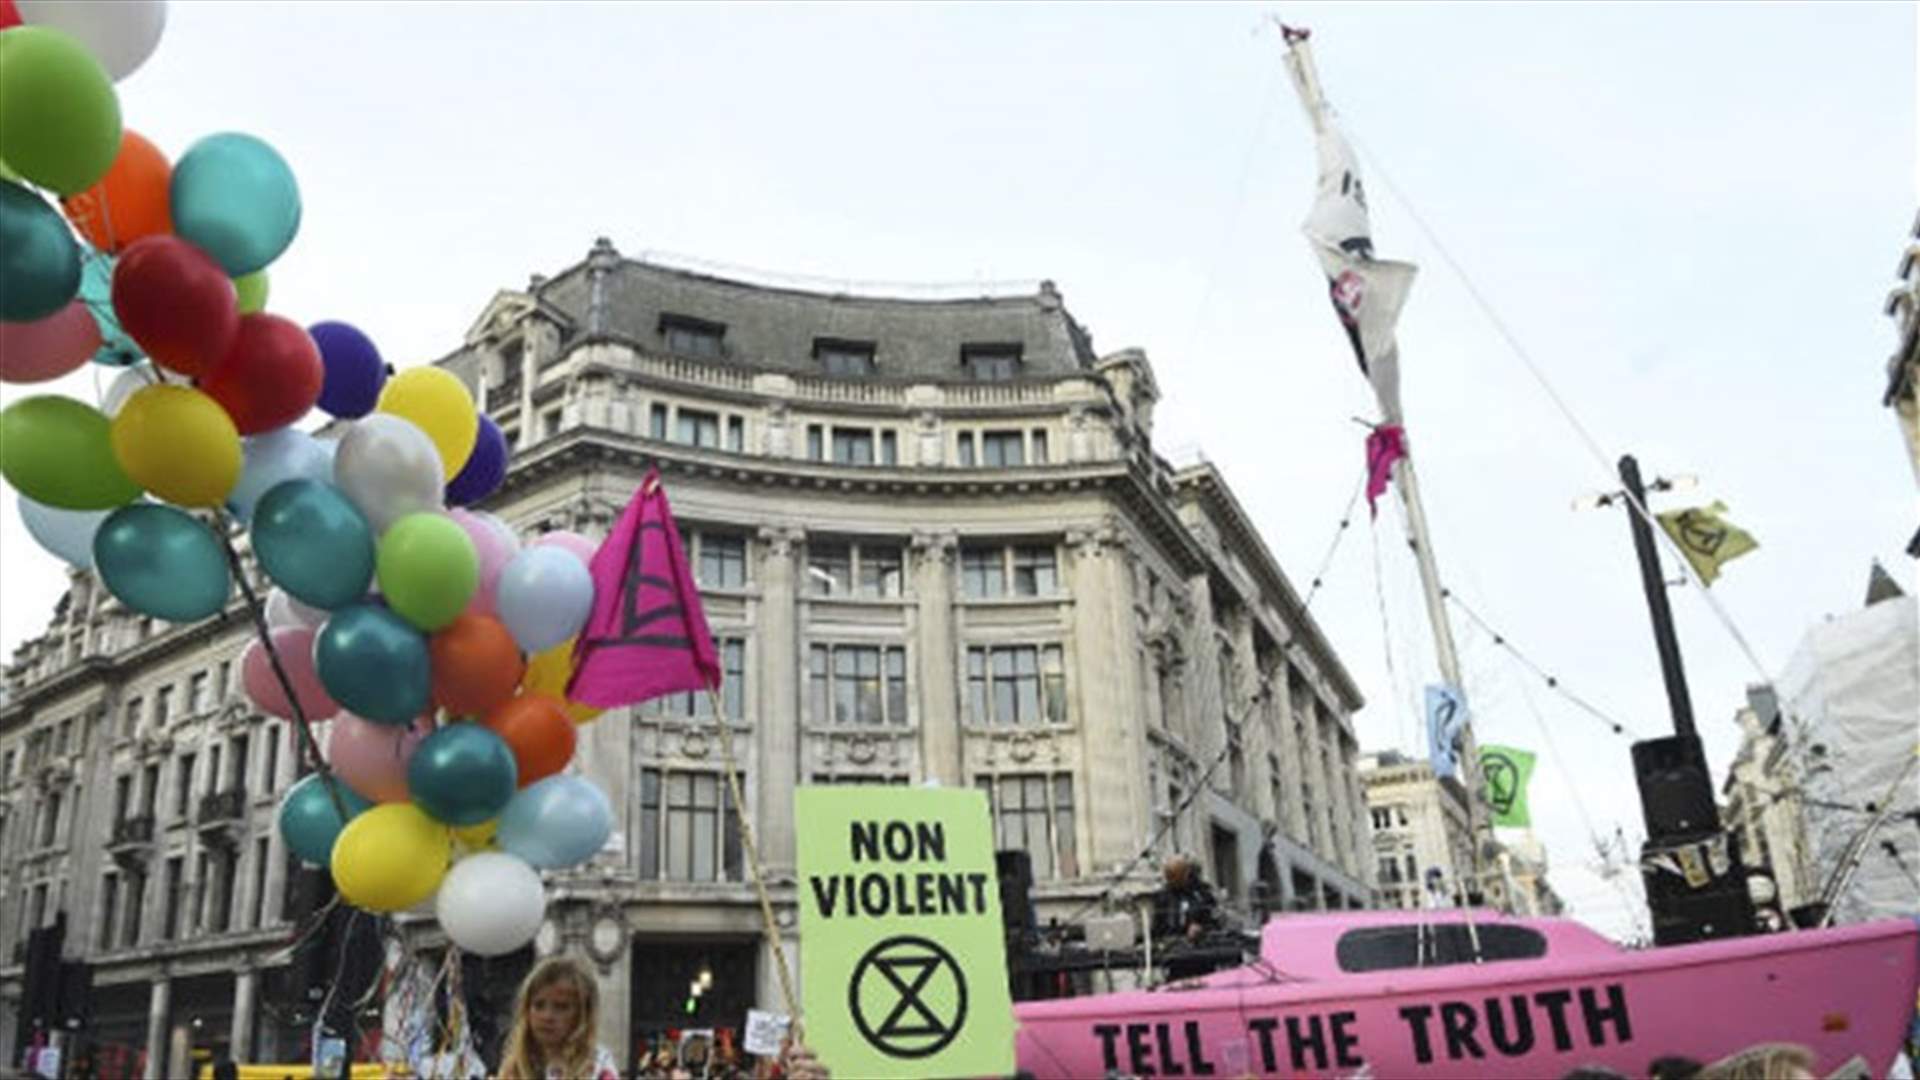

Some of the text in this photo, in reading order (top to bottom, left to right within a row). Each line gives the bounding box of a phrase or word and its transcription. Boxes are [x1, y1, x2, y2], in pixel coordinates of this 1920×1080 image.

[850, 821, 946, 863] NON
[810, 873, 988, 918] VIOLENT
[1093, 983, 1633, 1077] TELL THE TRUTH
